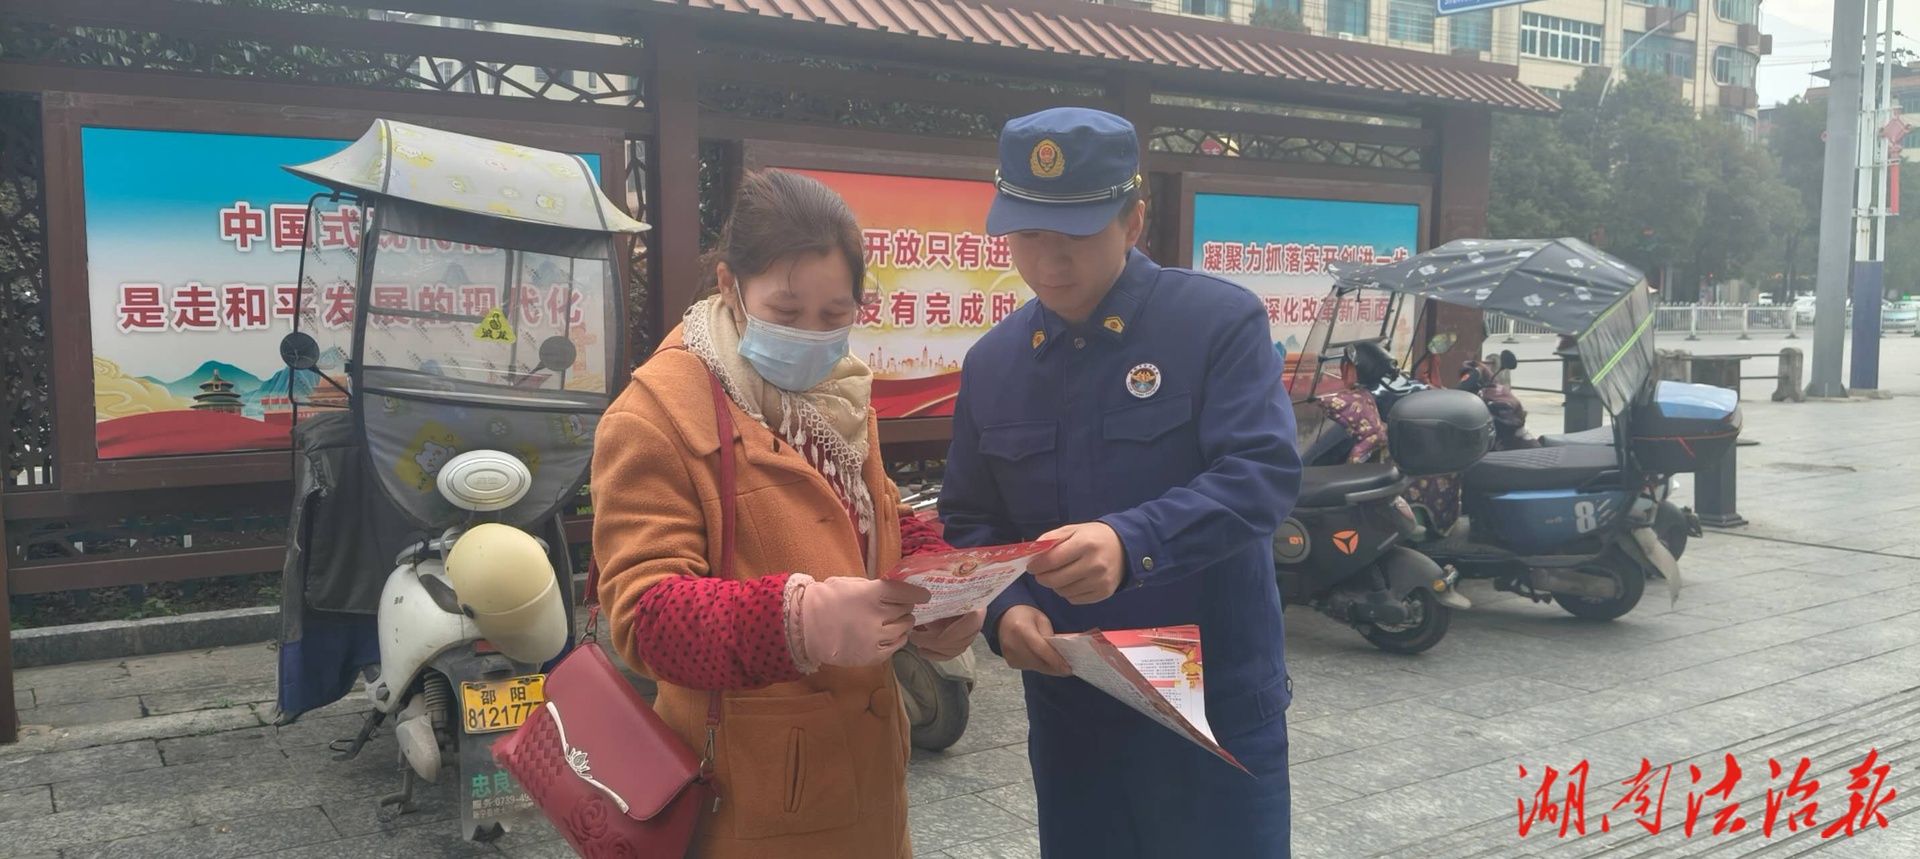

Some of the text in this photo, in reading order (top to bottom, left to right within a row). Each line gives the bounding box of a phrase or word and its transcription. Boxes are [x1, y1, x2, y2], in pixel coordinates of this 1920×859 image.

[120, 285, 581, 329] 是走和平发展的现代化
